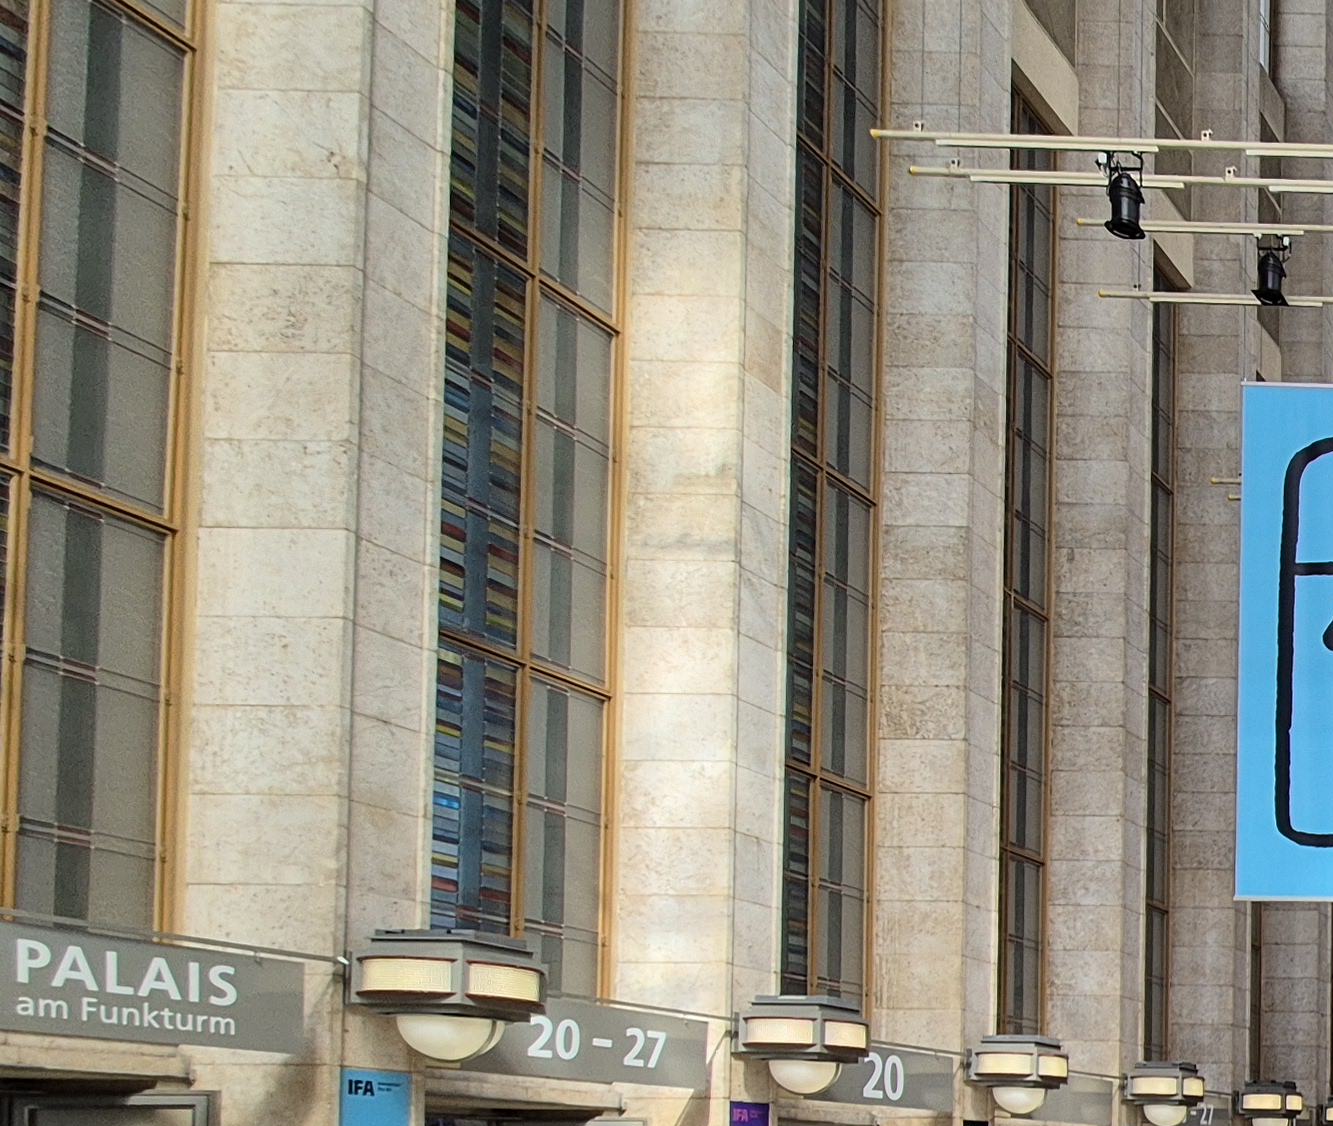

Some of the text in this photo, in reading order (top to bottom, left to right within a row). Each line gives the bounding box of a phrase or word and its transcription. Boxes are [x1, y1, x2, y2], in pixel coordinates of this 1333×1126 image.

[16, 938, 238, 1007] PALAIS
[16, 996, 236, 1036] am Funkturm
[527, 1015, 580, 1060] 20
[623, 1027, 667, 1068] 27
[348, 1079, 375, 1096] IFA
[863, 1052, 904, 1101] 20
